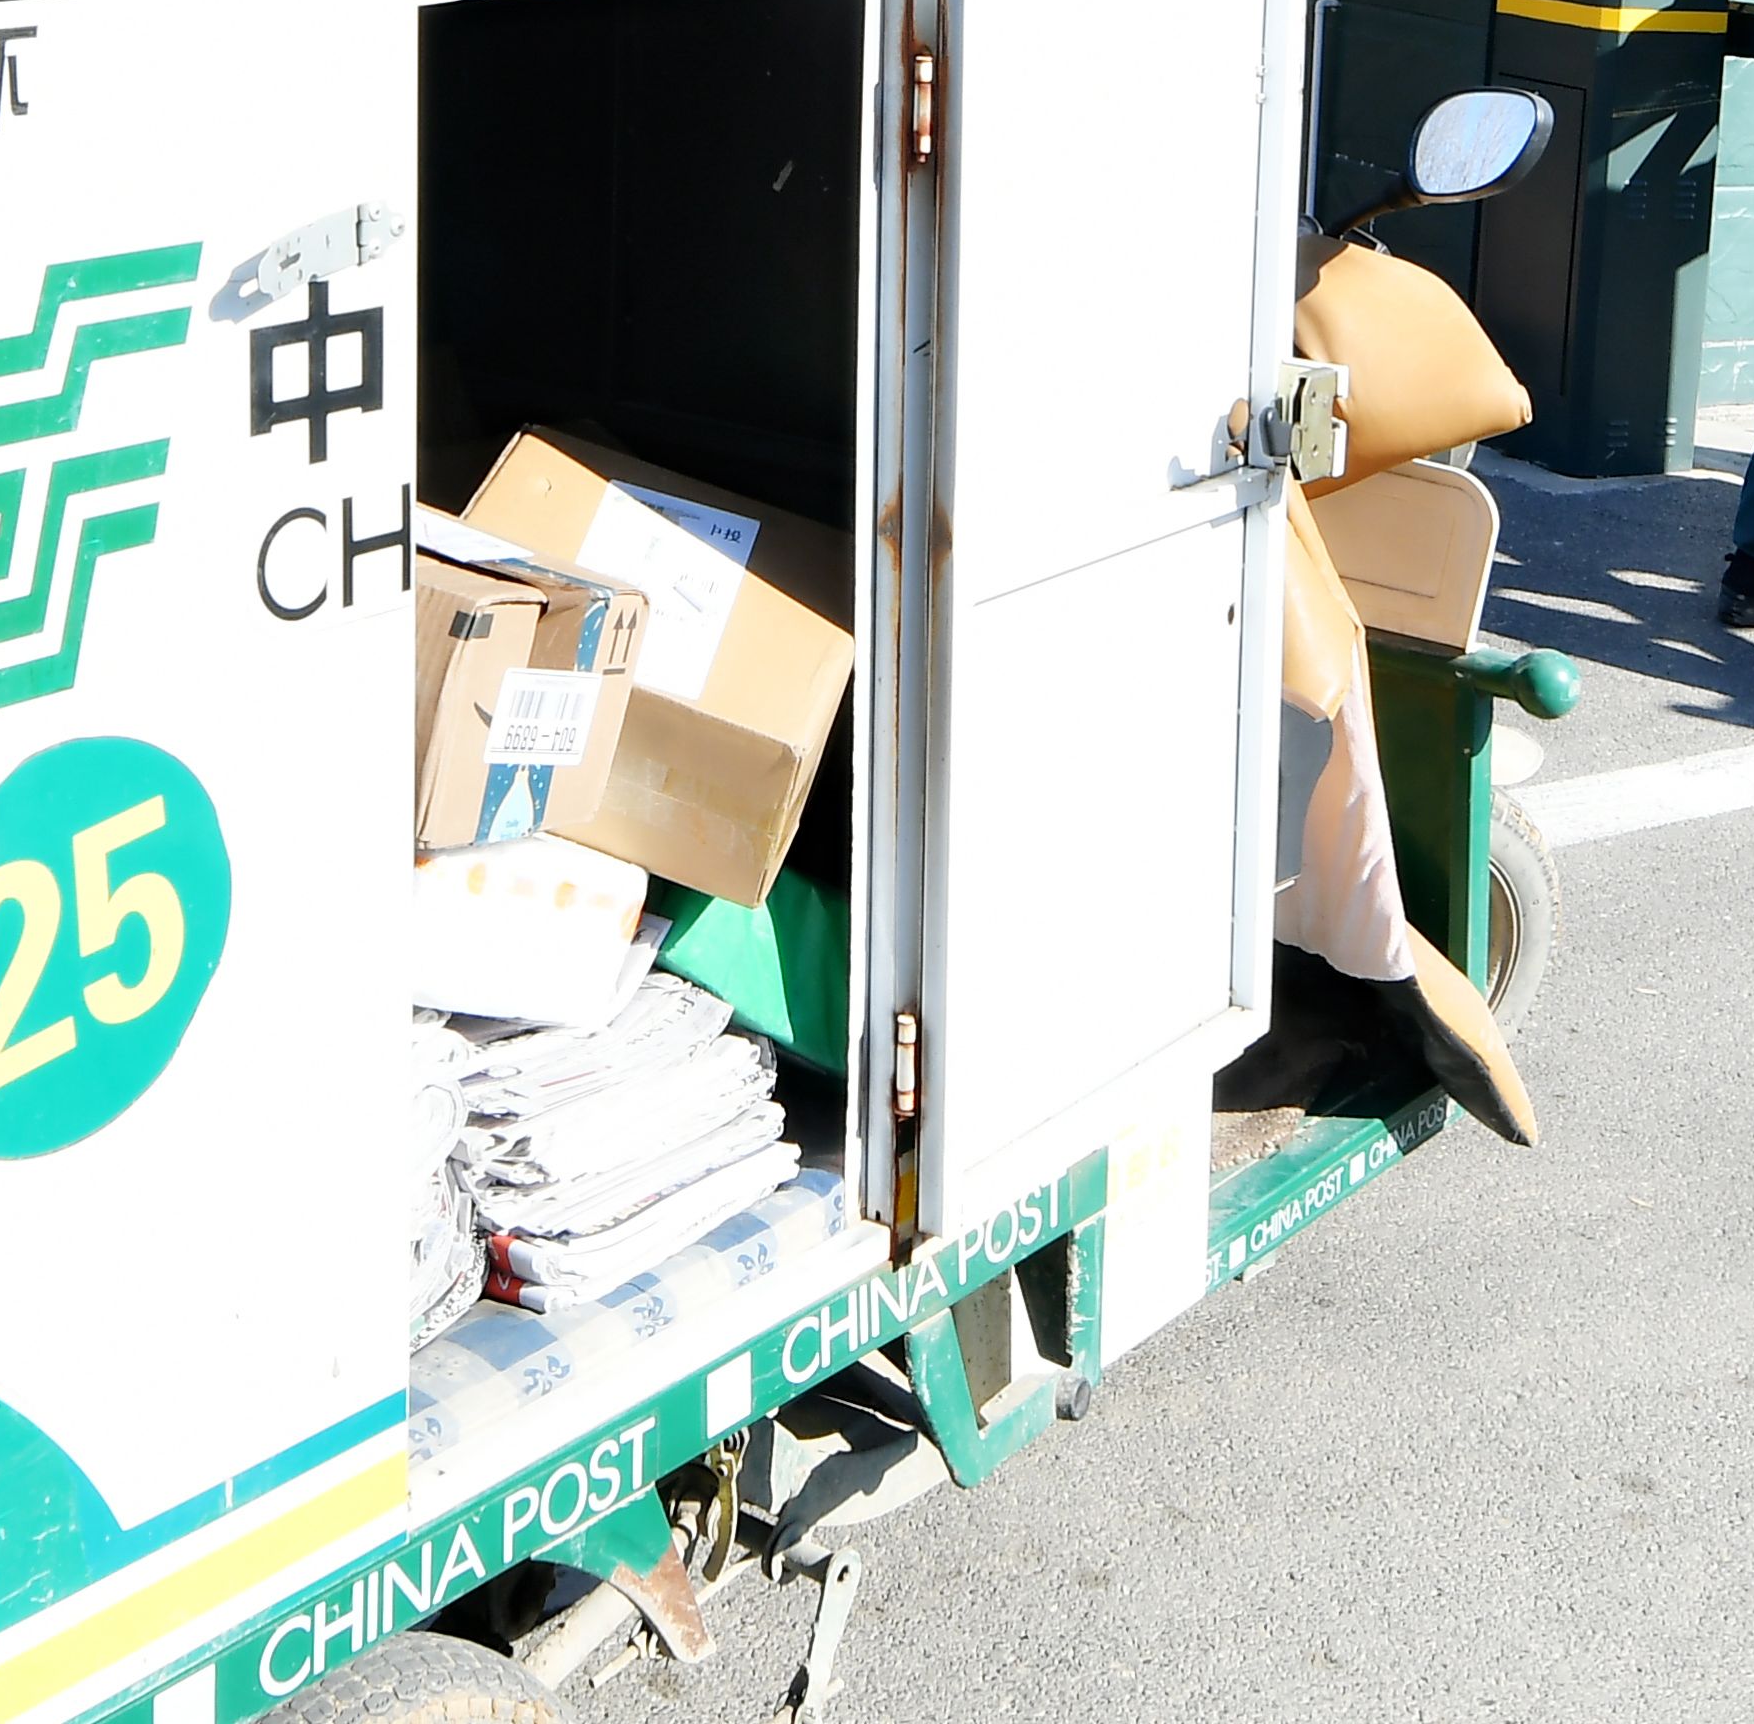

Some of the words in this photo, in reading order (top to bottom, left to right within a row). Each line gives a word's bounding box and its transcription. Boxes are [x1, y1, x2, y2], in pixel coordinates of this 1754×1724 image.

[249, 280, 385, 466] 中
[779, 1252, 953, 1390] CHINA
[956, 1164, 1078, 1293] POST
[1249, 1198, 1303, 1253] CHINA
[1303, 1166, 1346, 1218] POST
[255, 1524, 486, 1700] CHINA
[499, 1416, 660, 1567] POST
